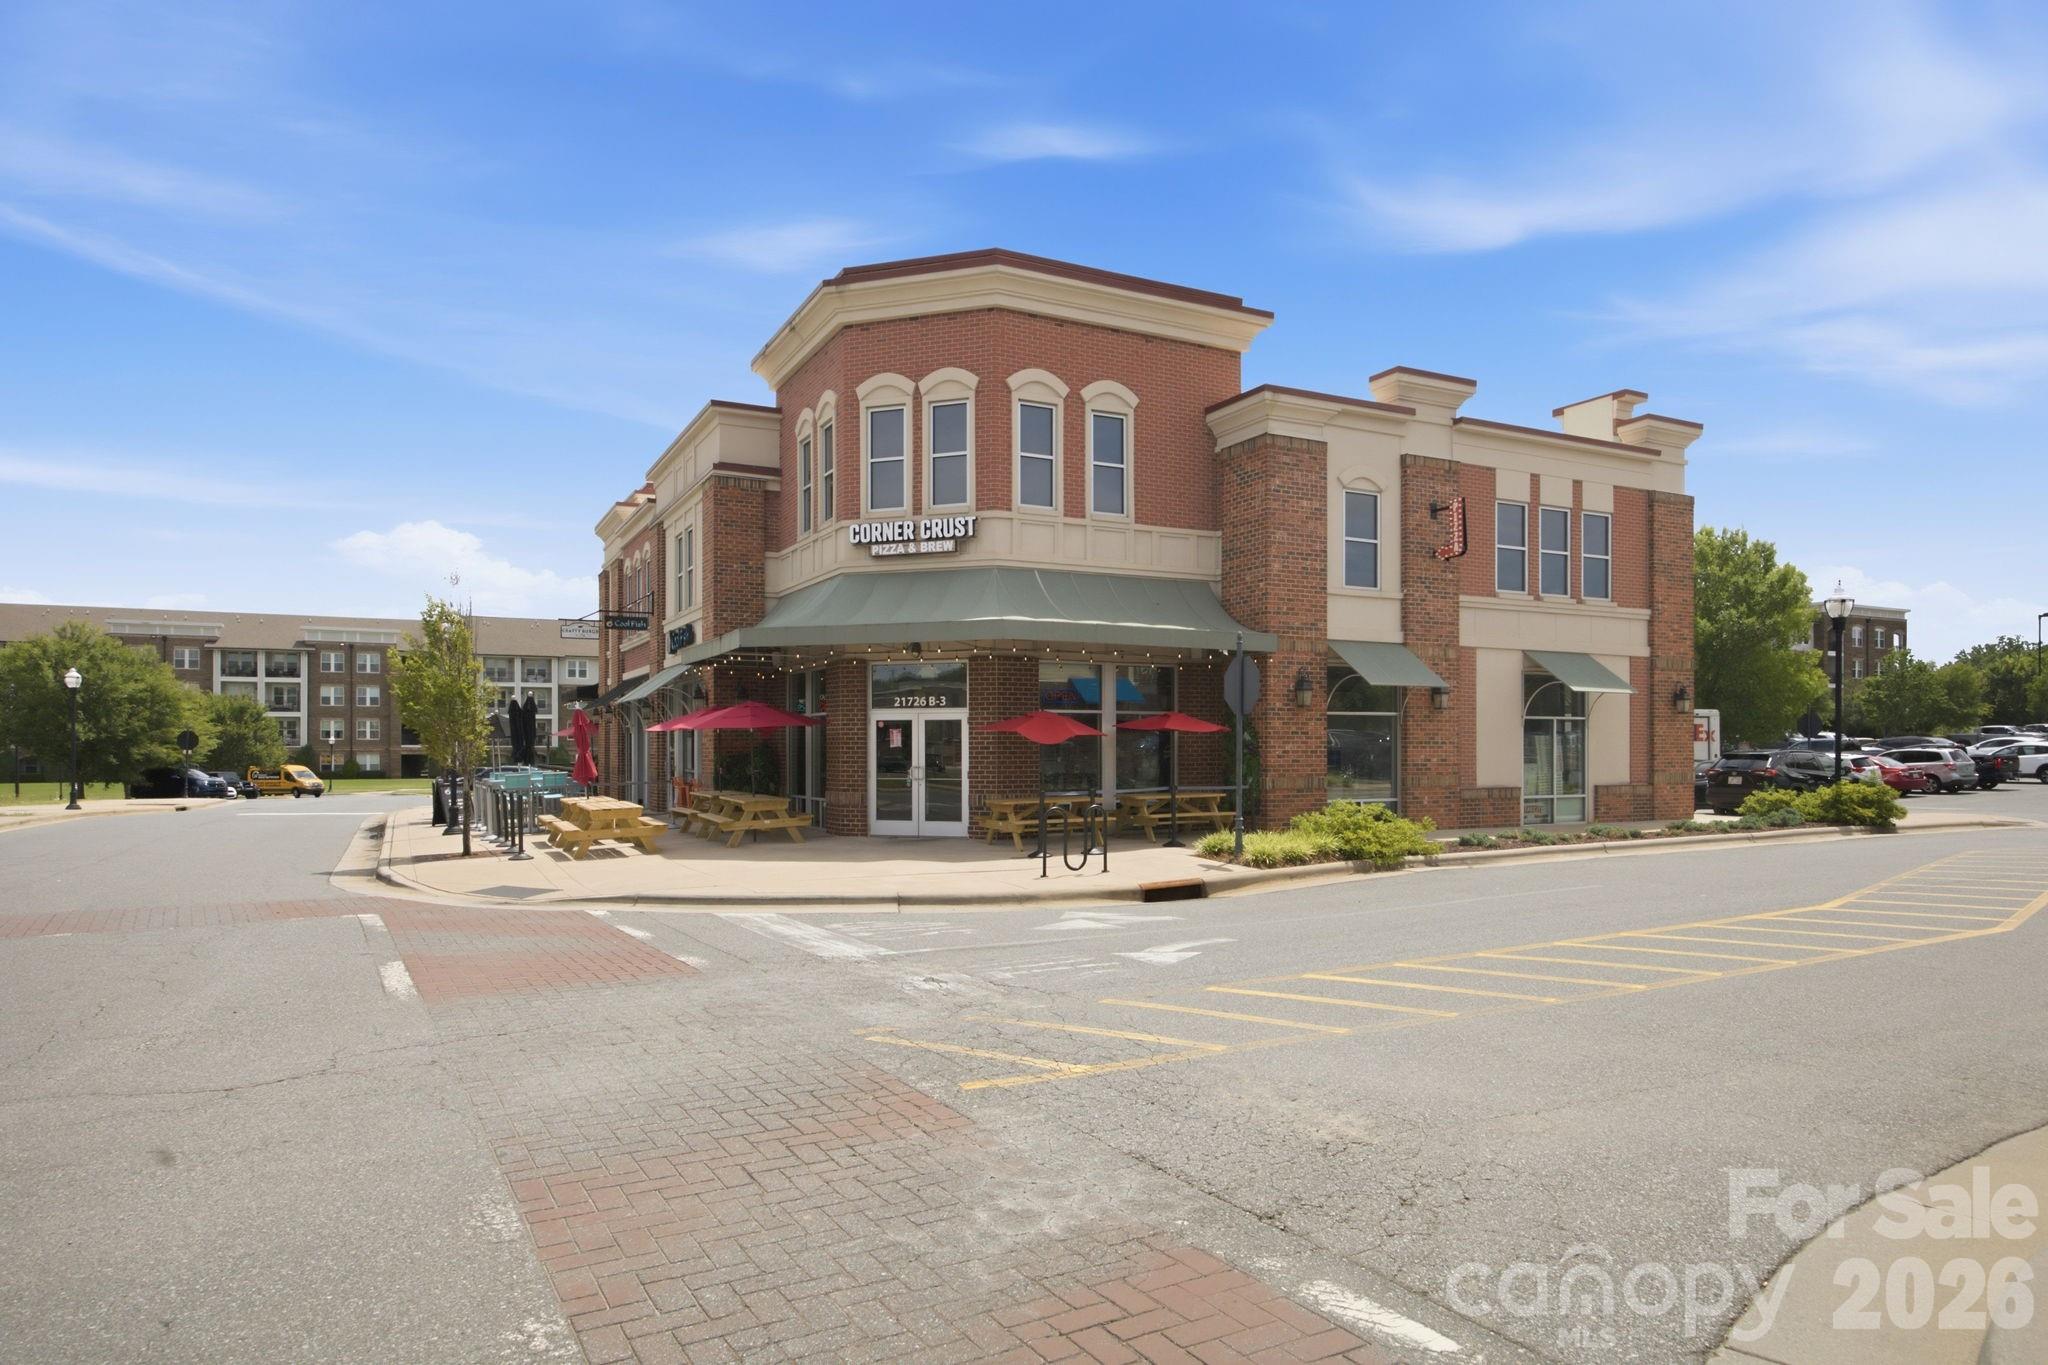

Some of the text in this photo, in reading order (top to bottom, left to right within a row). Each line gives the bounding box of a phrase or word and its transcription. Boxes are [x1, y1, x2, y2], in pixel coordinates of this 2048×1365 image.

[850, 516, 977, 544] CORNER CRUST
[871, 540, 954, 556] PIZZA & BREW
[894, 696, 946, 707] 21726 B-3
[1694, 723, 1716, 742] Ex
